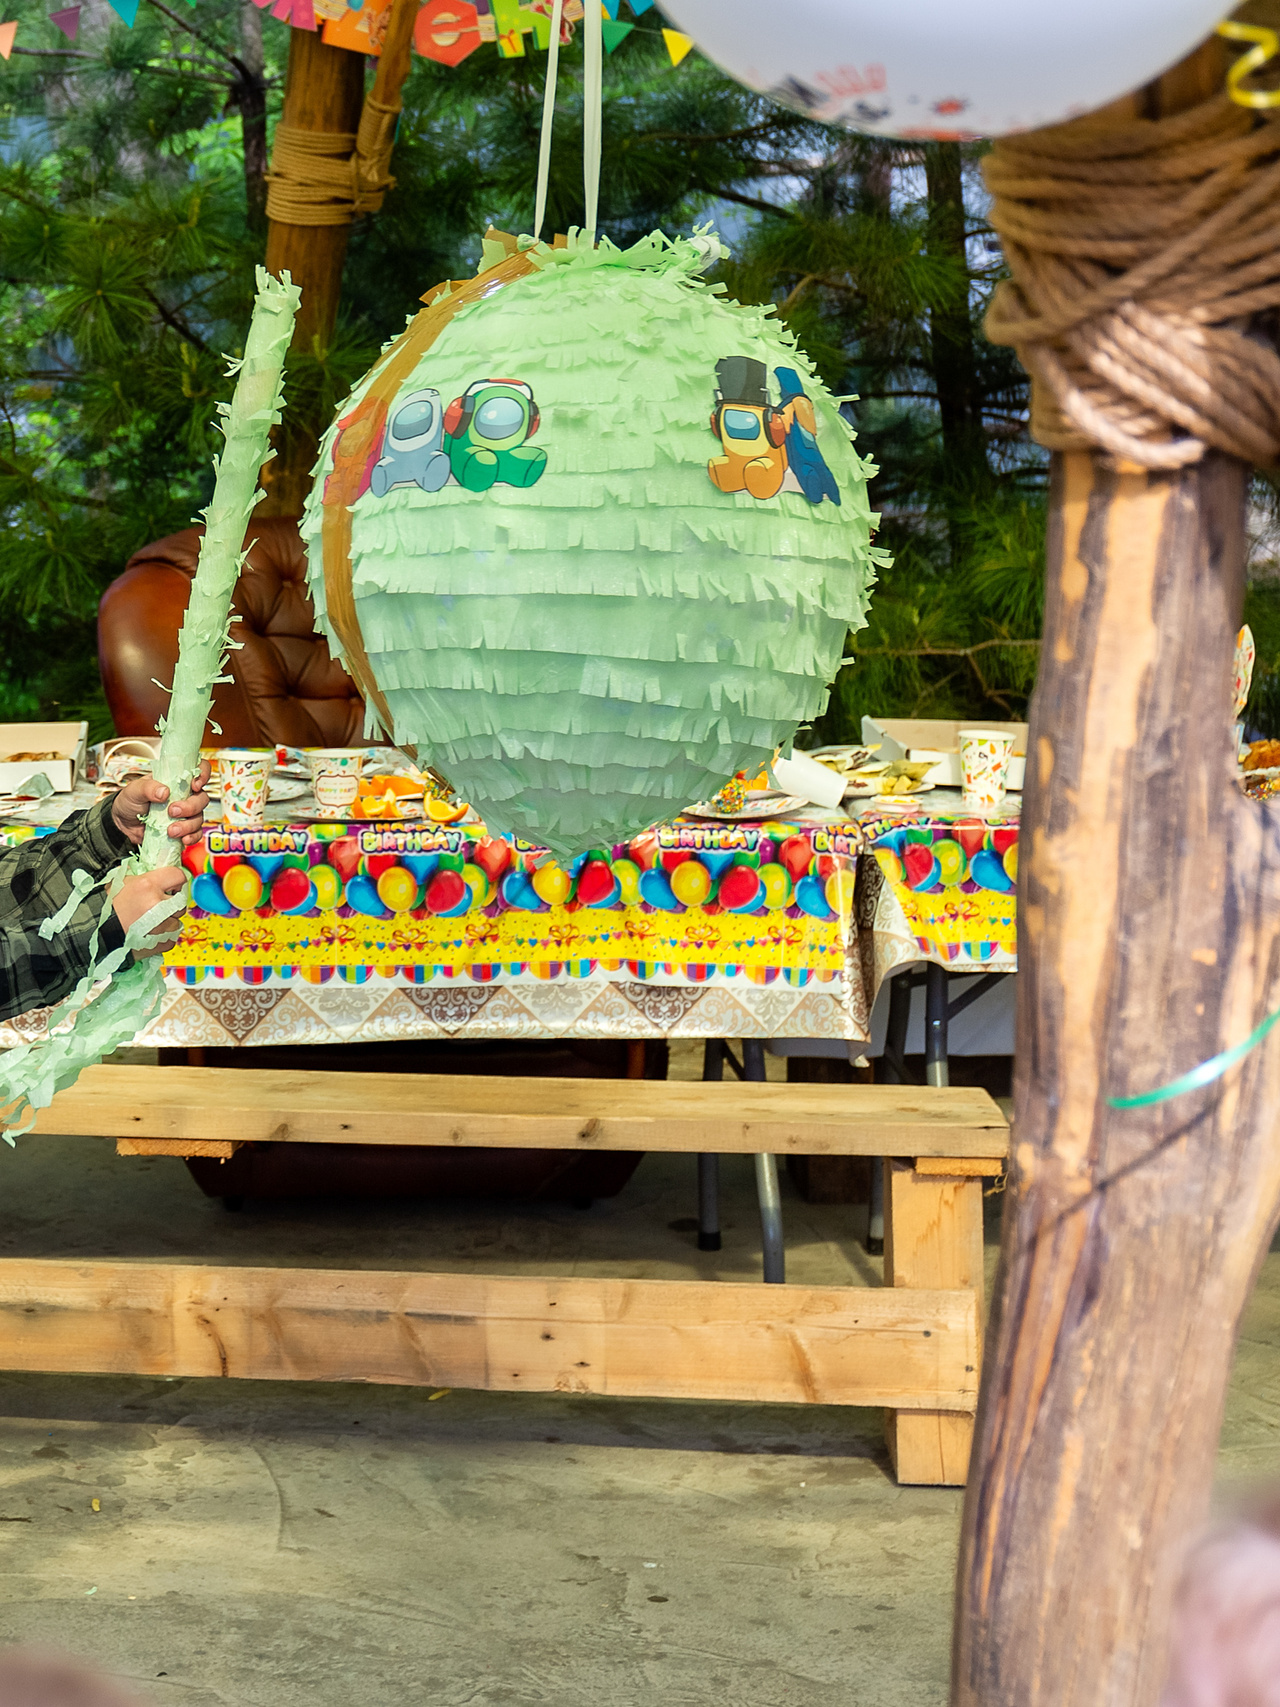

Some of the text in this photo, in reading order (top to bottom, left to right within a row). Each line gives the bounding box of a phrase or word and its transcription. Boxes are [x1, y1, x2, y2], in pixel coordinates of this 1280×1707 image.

[209, 831, 307, 853] BIRTHDAY
[361, 831, 460, 853] BIRTHDAY
[659, 828, 759, 850] BIRTHDAY
